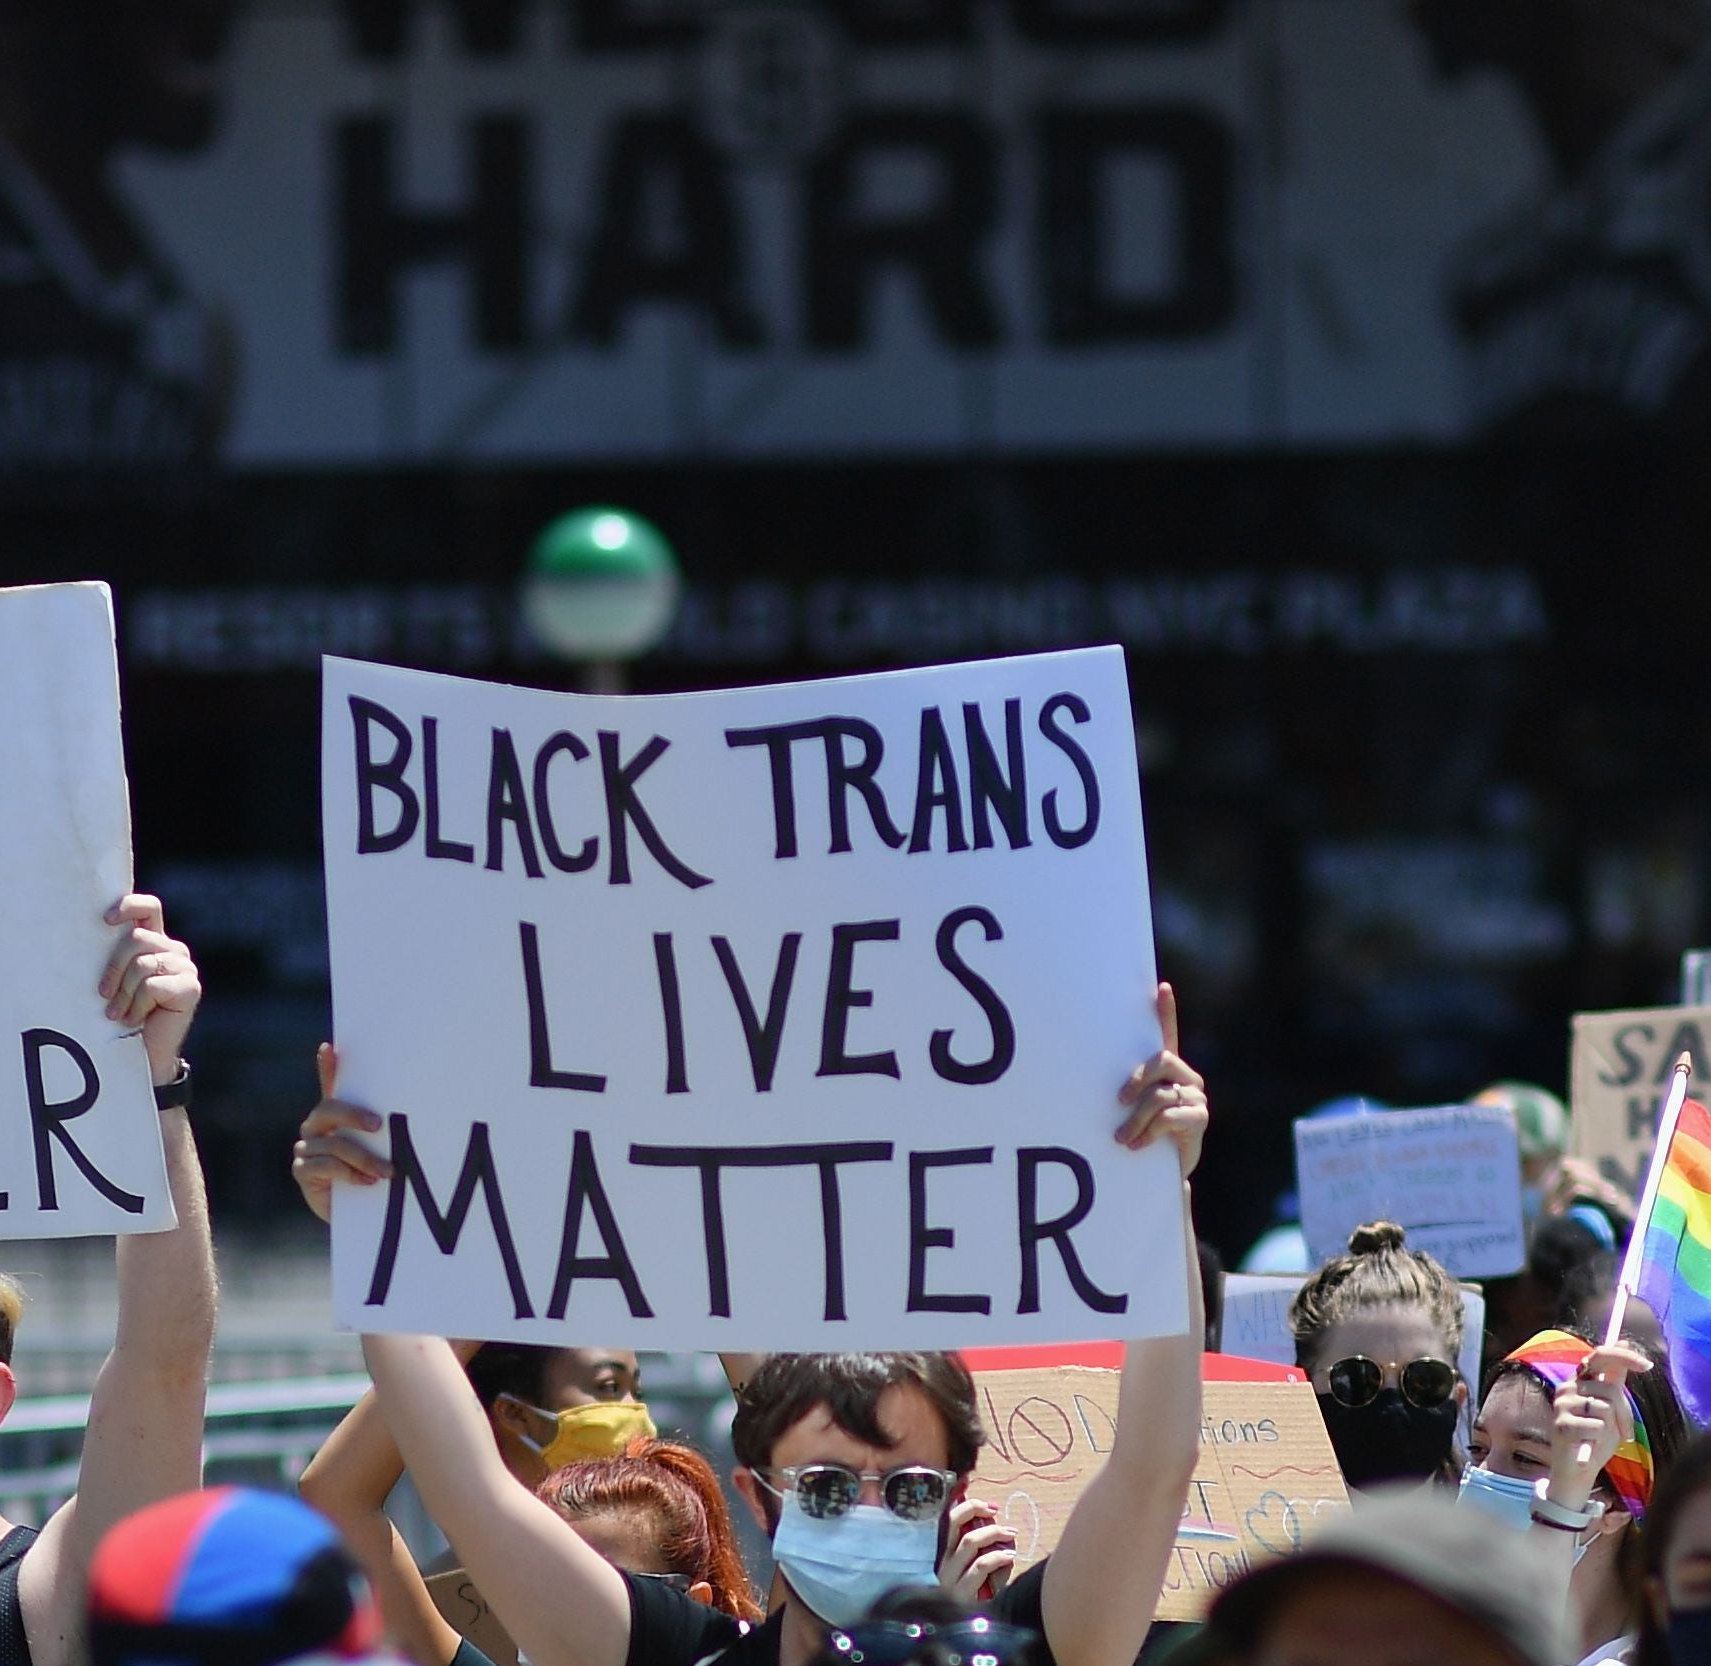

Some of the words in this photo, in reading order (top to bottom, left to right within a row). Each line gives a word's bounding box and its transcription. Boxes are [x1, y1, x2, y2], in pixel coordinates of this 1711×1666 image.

[330, 106, 1240, 356] HARD
[348, 694, 714, 889] BLACK
[725, 691, 1101, 859] TRANS
[518, 905, 1016, 1093] LIVES
[364, 1112, 1128, 1322] MATTER
